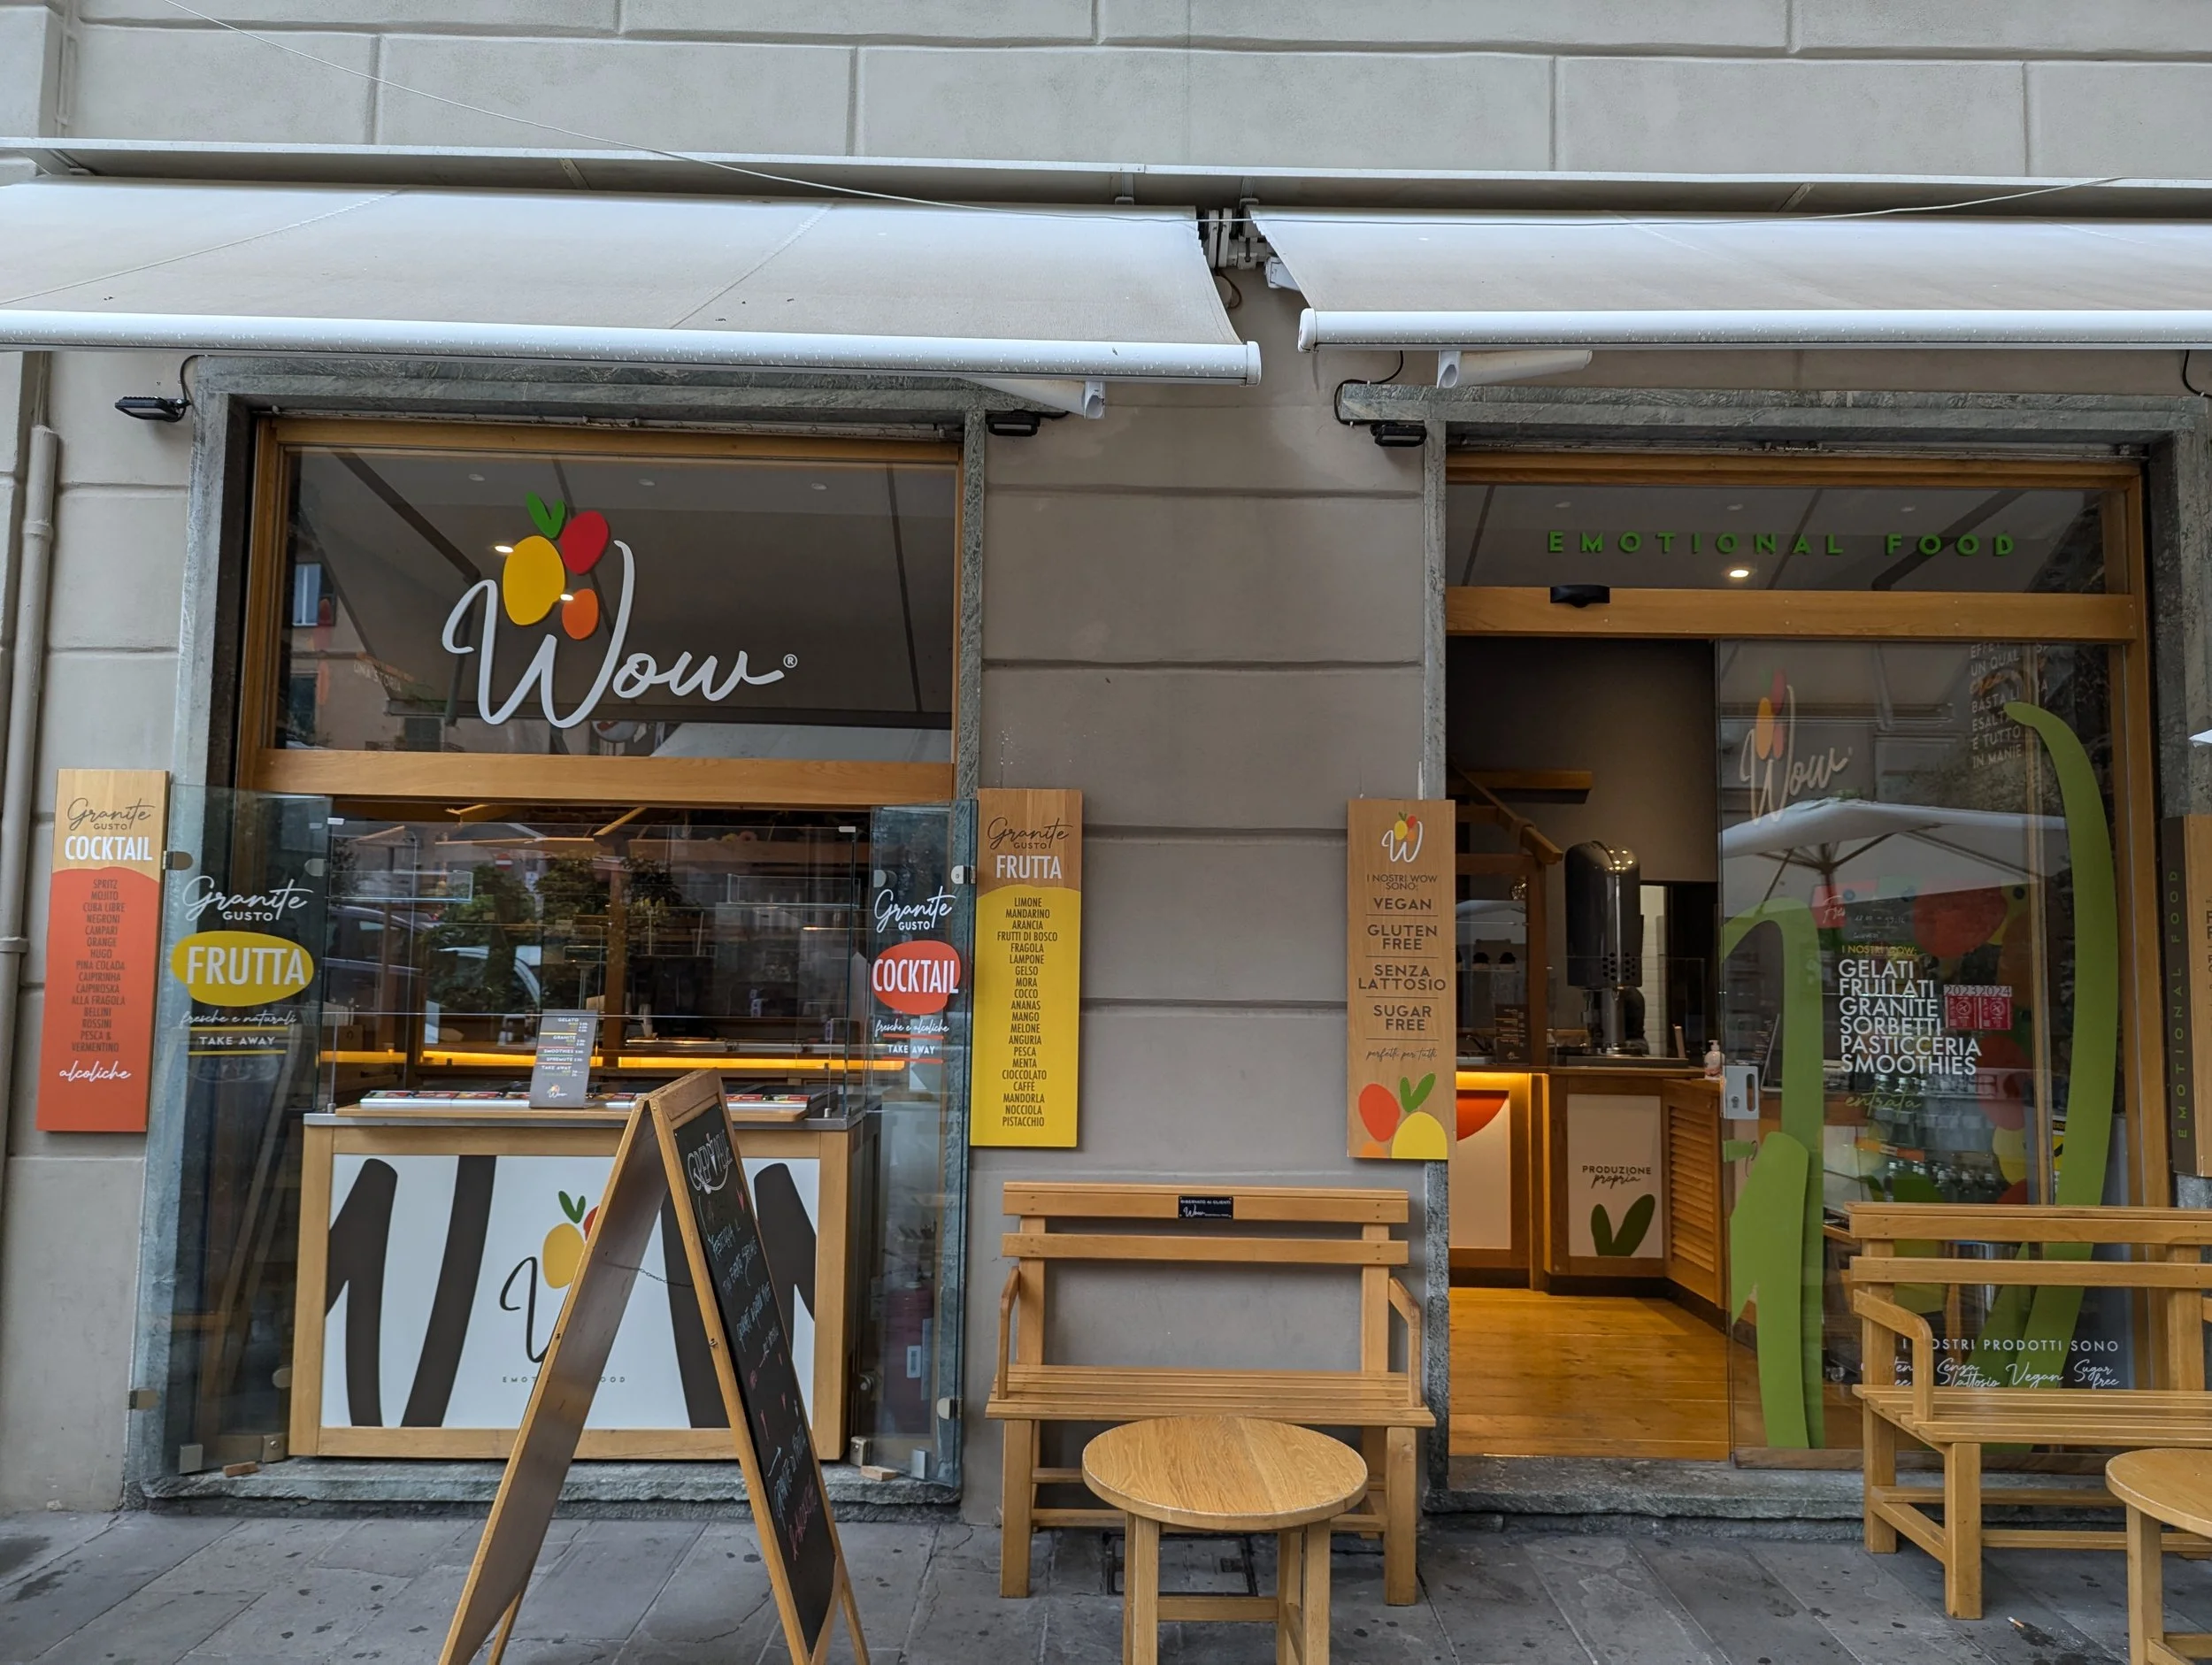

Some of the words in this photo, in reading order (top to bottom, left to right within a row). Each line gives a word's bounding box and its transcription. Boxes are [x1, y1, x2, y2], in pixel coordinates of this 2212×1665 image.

[1548, 531, 1844, 556] EMOTIONAL
[1885, 533, 2015, 556] FOOD
[442, 540, 786, 729] Wow
[1982, 725, 2022, 748] TUTTO
[1740, 684, 1848, 825] Wow
[66, 797, 156, 832] Granite
[987, 817, 1073, 850] Granite
[1381, 821, 1424, 863] W
[65, 835, 154, 861] COCKTAIL
[995, 855, 1062, 879] FRUTTA
[92, 879, 118, 889] SPRITZ
[1372, 874, 1407, 883] NOSTRI
[1409, 874, 1438, 883] WOW
[90, 891, 119, 901] MOJITO
[182, 875, 314, 921] Granite
[82, 902, 103, 912] CUBA
[104, 902, 126, 912] LIBRE
[1014, 897, 1042, 908] LIMONE
[1373, 898, 1432, 910] VEGAN
[2168, 871, 2180, 943] FOOD
[874, 886, 956, 933] Granite
[1005, 909, 1050, 919] MANDARINO
[87, 914, 120, 924] NEGRONI
[223, 911, 274, 922] GUSTO
[85, 925, 118, 935] CAMPARI
[898, 921, 931, 931] GUSTO
[1011, 920, 1043, 930] ARANCIA
[1367, 924, 1438, 937] GLUTEN
[87, 937, 116, 948] ORANGE
[997, 932, 1022, 941] FRUTTI
[1023, 932, 1032, 941] DI
[1033, 932, 1058, 942] BOSCO
[1010, 943, 1044, 953] FRAGOLA
[1382, 938, 1423, 950] FREE
[90, 948, 112, 958] HUGO
[1847, 945, 1884, 955] NOSTRI
[1010, 954, 1045, 964] LAMPONE
[187, 946, 305, 986] FRUTTA
[1015, 965, 1039, 976] GELSO
[1374, 964, 1431, 977] SENZA
[1838, 958, 1914, 978] GELATI
[872, 958, 959, 994] COCKTAIL
[1015, 977, 1037, 987] MORA
[1358, 978, 1446, 991] LATTOSIO
[1014, 988, 1038, 999] COCCO
[1839, 978, 1935, 998] FRULLATI
[1946, 986, 1978, 995] 2023
[1980, 986, 2011, 996] 2024
[91, 995, 126, 1005] FRAGOLA
[1010, 1000, 1041, 1010] ANANAS
[1373, 1004, 1432, 1017] SUGAR
[1839, 997, 1939, 1017] GRANITE
[179, 1009, 230, 1030] fresche
[242, 1009, 297, 1027] naturali
[1011, 1011, 1040, 1022] MANGO
[874, 1018, 904, 1038] fresche
[1010, 1024, 1041, 1033] MELONE
[1386, 1018, 1425, 1031] FREE
[1839, 1016, 1941, 1036] SORBETTI
[81, 1030, 104, 1040] PESCA
[199, 1036, 234, 1045] TAKE
[239, 1036, 276, 1045] AWAY
[1008, 1035, 1041, 1045] ANGURIA
[887, 1045, 909, 1054] TAKE
[912, 1045, 935, 1055] AWAY
[1840, 1035, 1982, 1056] PASTICCERIA
[1013, 1047, 1037, 1056] PESCA
[1400, 1050, 1416, 1062] per
[2172, 968, 2187, 1138] EMOTIONAL
[1012, 1058, 1037, 1068] MENTA
[1841, 1055, 1977, 1075] SMOOTHIES
[59, 1060, 132, 1082] alcoliche
[1002, 1070, 1048, 1080] CIOCCOLATO
[1002, 1093, 1045, 1103] MANDORLA
[1845, 1085, 1922, 1118] entrata
[1005, 1105, 1042, 1115] NOCCIOLA
[1002, 1116, 1045, 1127] PISTACCHIO
[1582, 1165, 1652, 1175] PRODUZIONE
[1591, 1172, 1641, 1189] propria
[1902, 1338, 1907, 1349] I
[1932, 1339, 1975, 1350] OSTRI
[1983, 1339, 2062, 1352] PRODOTTI
[2070, 1340, 2119, 1353] SONO
[1937, 1357, 1980, 1385] Senza
[2005, 1362, 2065, 1389] Vegan
[2073, 1358, 2113, 1382] Sugar
